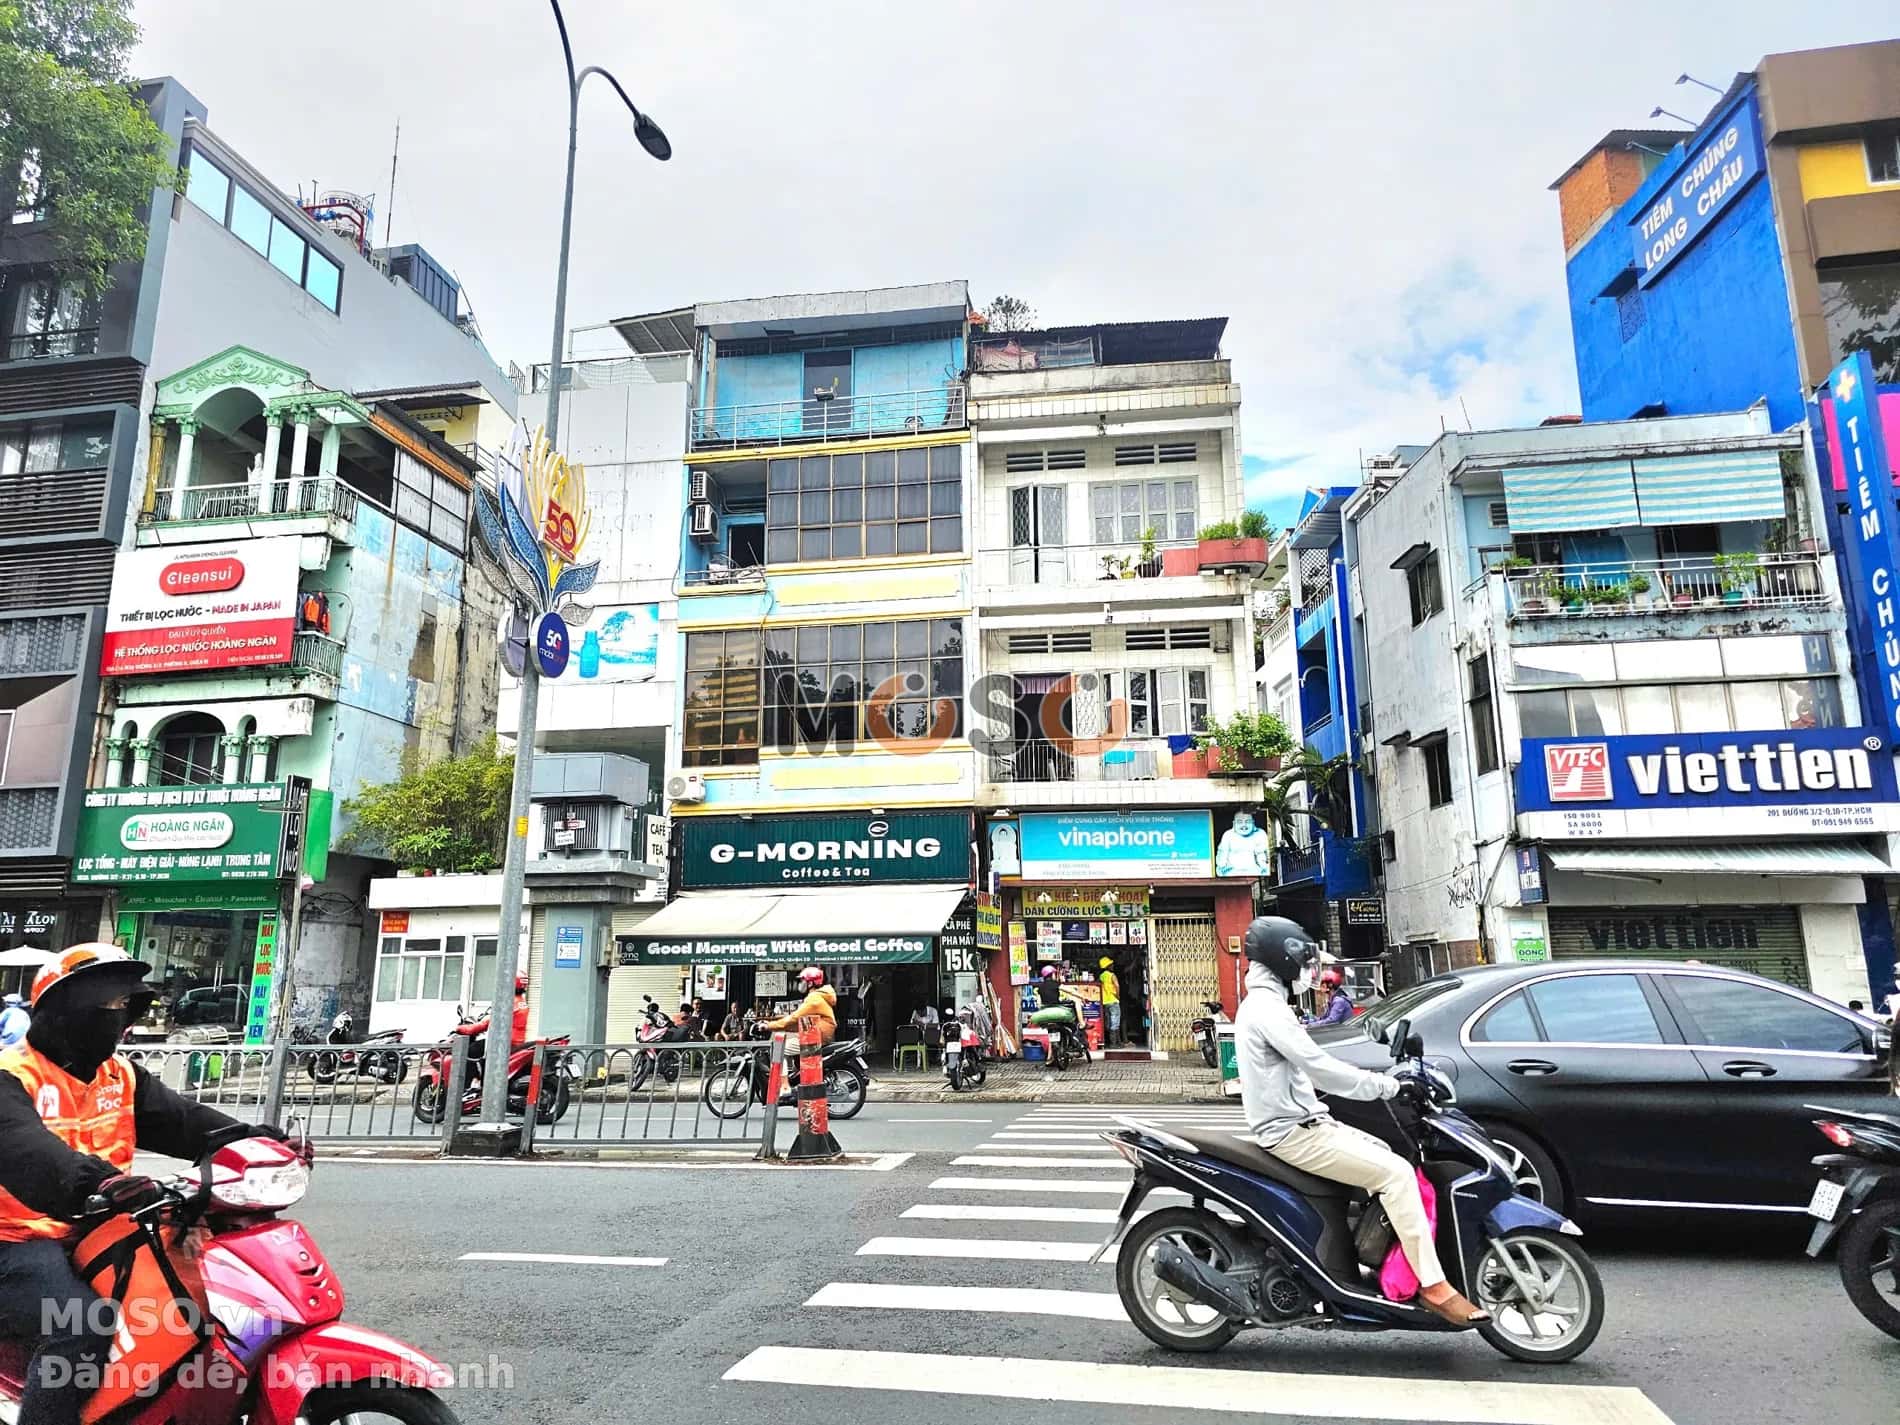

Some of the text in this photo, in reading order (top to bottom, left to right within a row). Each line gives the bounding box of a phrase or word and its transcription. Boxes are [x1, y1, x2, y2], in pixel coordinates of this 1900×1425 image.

[1641, 127, 1738, 240] TIÊM CHỦNG
[1645, 155, 1743, 271] LONG CHÂU
[1847, 416, 1880, 541] TIÊM
[546, 499, 576, 551] 50
[167, 566, 232, 585] Cleansui
[154, 609, 174, 621] LỌC
[175, 604, 203, 618] NƯỚC
[212, 603, 239, 614] MADE
[240, 602, 249, 612] IN
[250, 600, 281, 611] JAPAN
[127, 641, 159, 656] THỐNG
[160, 643, 181, 656] LỌC
[182, 638, 208, 652] NƯỚC
[210, 637, 246, 650] HOÀNG
[1550, 747, 1604, 770] VTEC
[1627, 743, 1873, 795] viettien
[151, 818, 226, 833] HOÀNG NGÂN
[1058, 826, 1175, 849] vinaphone
[652, 843, 664, 856] TEA
[710, 838, 941, 863] G-MORNING
[78, 857, 93, 872] LỌC
[225, 854, 250, 867] TRUNG
[782, 867, 829, 879] Coffee
[845, 866, 870, 877] Tea
[1046, 904, 1080, 916] CƯỜNG
[942, 932, 975, 945] PHA MÁY
[1584, 911, 1760, 950] viettien
[648, 938, 924, 956] Good Morning With Good Coffee
[944, 948, 974, 971] 15k
